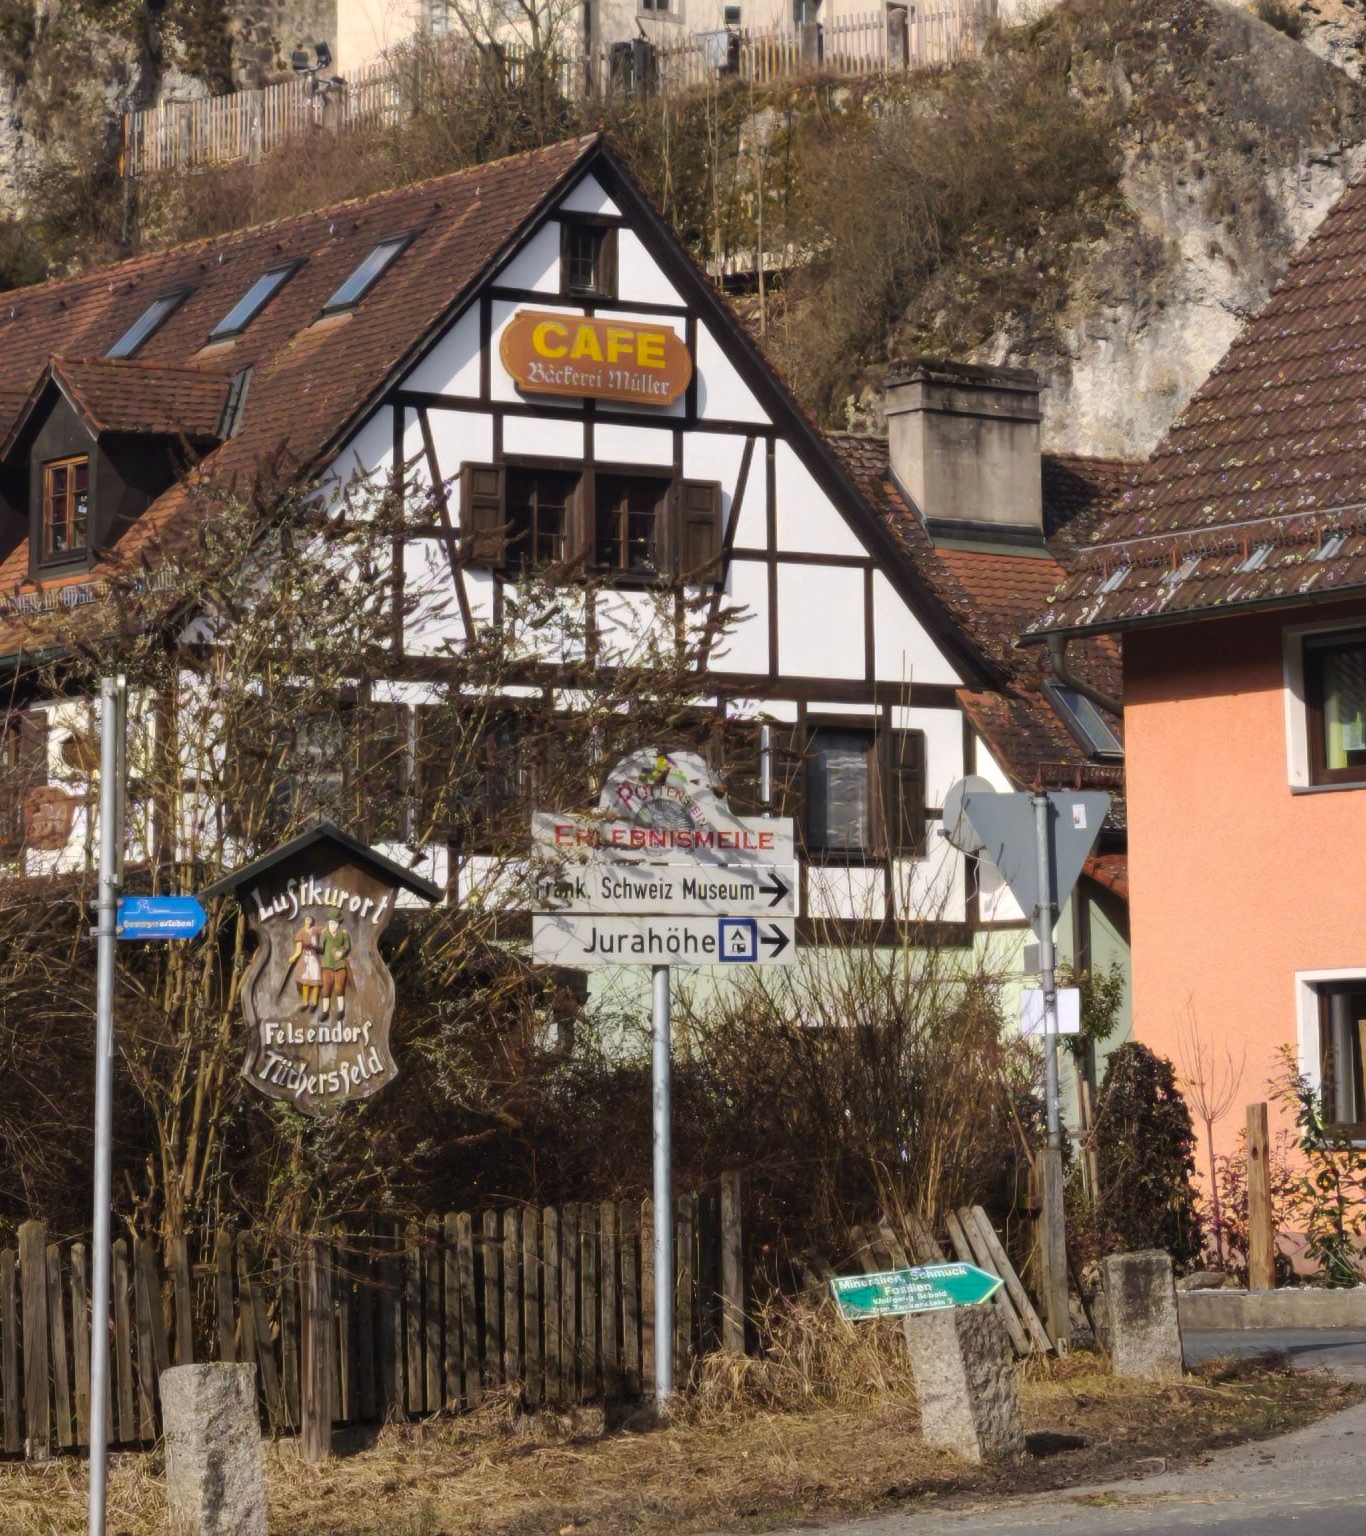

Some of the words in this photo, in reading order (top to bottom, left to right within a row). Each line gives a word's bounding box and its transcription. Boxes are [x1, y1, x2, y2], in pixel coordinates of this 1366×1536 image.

[531, 321, 665, 368] CAFE
[527, 362, 602, 388] Bäckerei
[608, 370, 669, 395] Müller
[251, 875, 389, 925] Luftkurort
[601, 876, 673, 900] Schweiz
[683, 877, 754, 901] Museum
[583, 927, 716, 954] Jurahöhe
[265, 1020, 372, 1046] Felsendorf
[259, 1046, 385, 1098] Tüchersfeld
[910, 1266, 967, 1281] Schmuck
